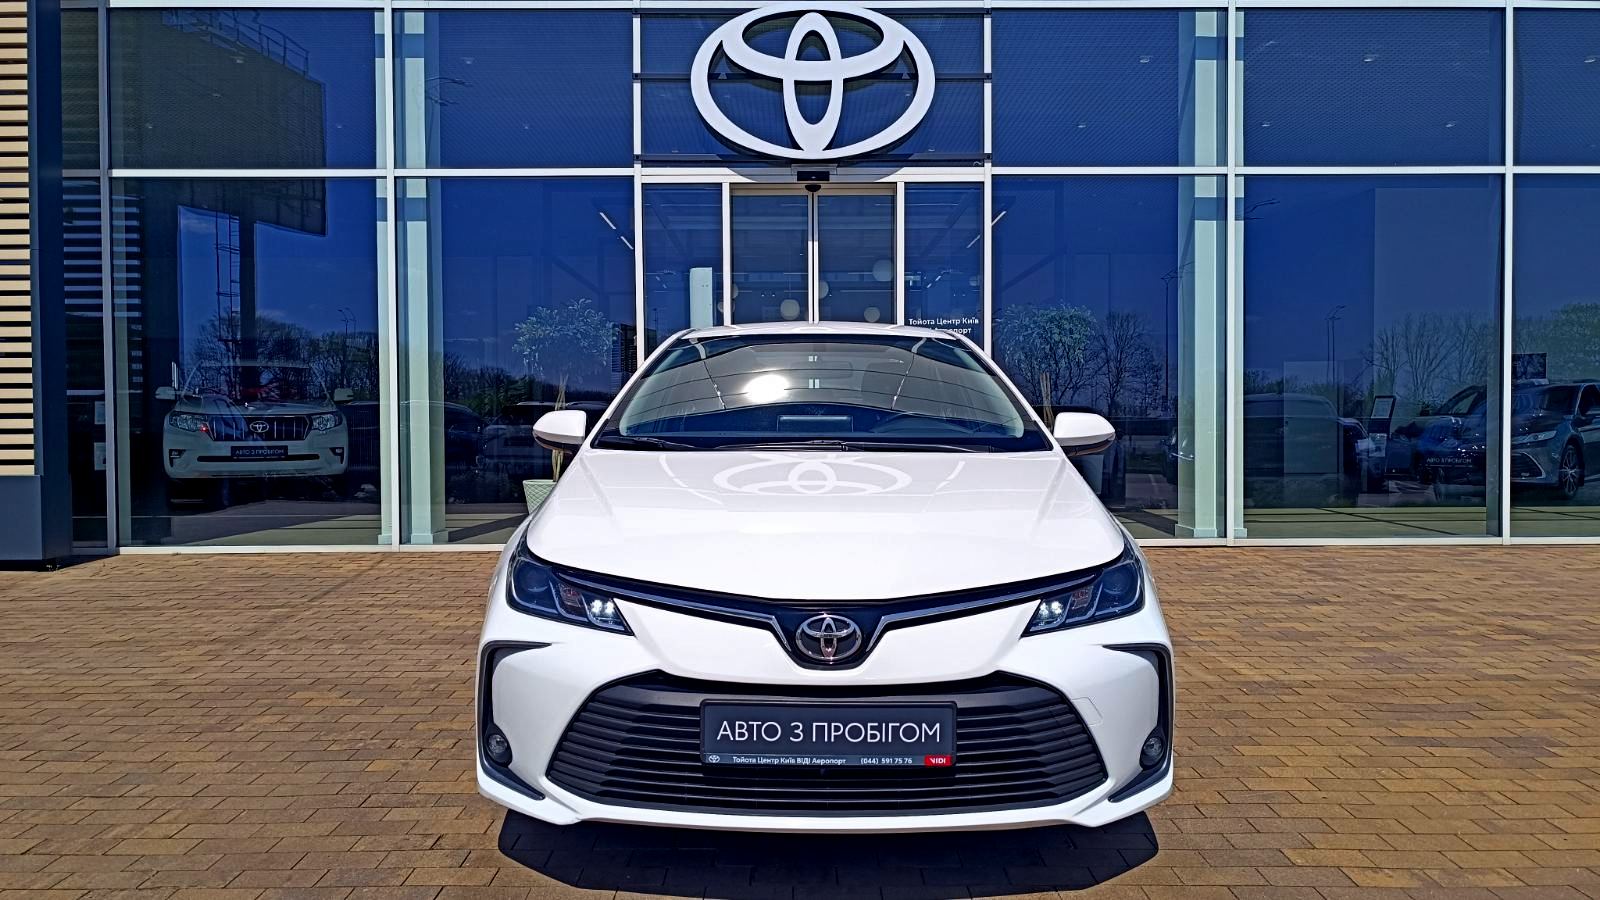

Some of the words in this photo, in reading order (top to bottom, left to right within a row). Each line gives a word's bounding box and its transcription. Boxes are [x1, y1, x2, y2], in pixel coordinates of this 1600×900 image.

[936, 318, 961, 326] Центр
[716, 720, 782, 742] АВТО
[789, 722, 804, 742] З
[812, 722, 941, 743] ПРОБІГОМ
[732, 756, 756, 764] Тойота
[757, 757, 779, 765] Центр
[796, 757, 811, 765] ВІДІ
